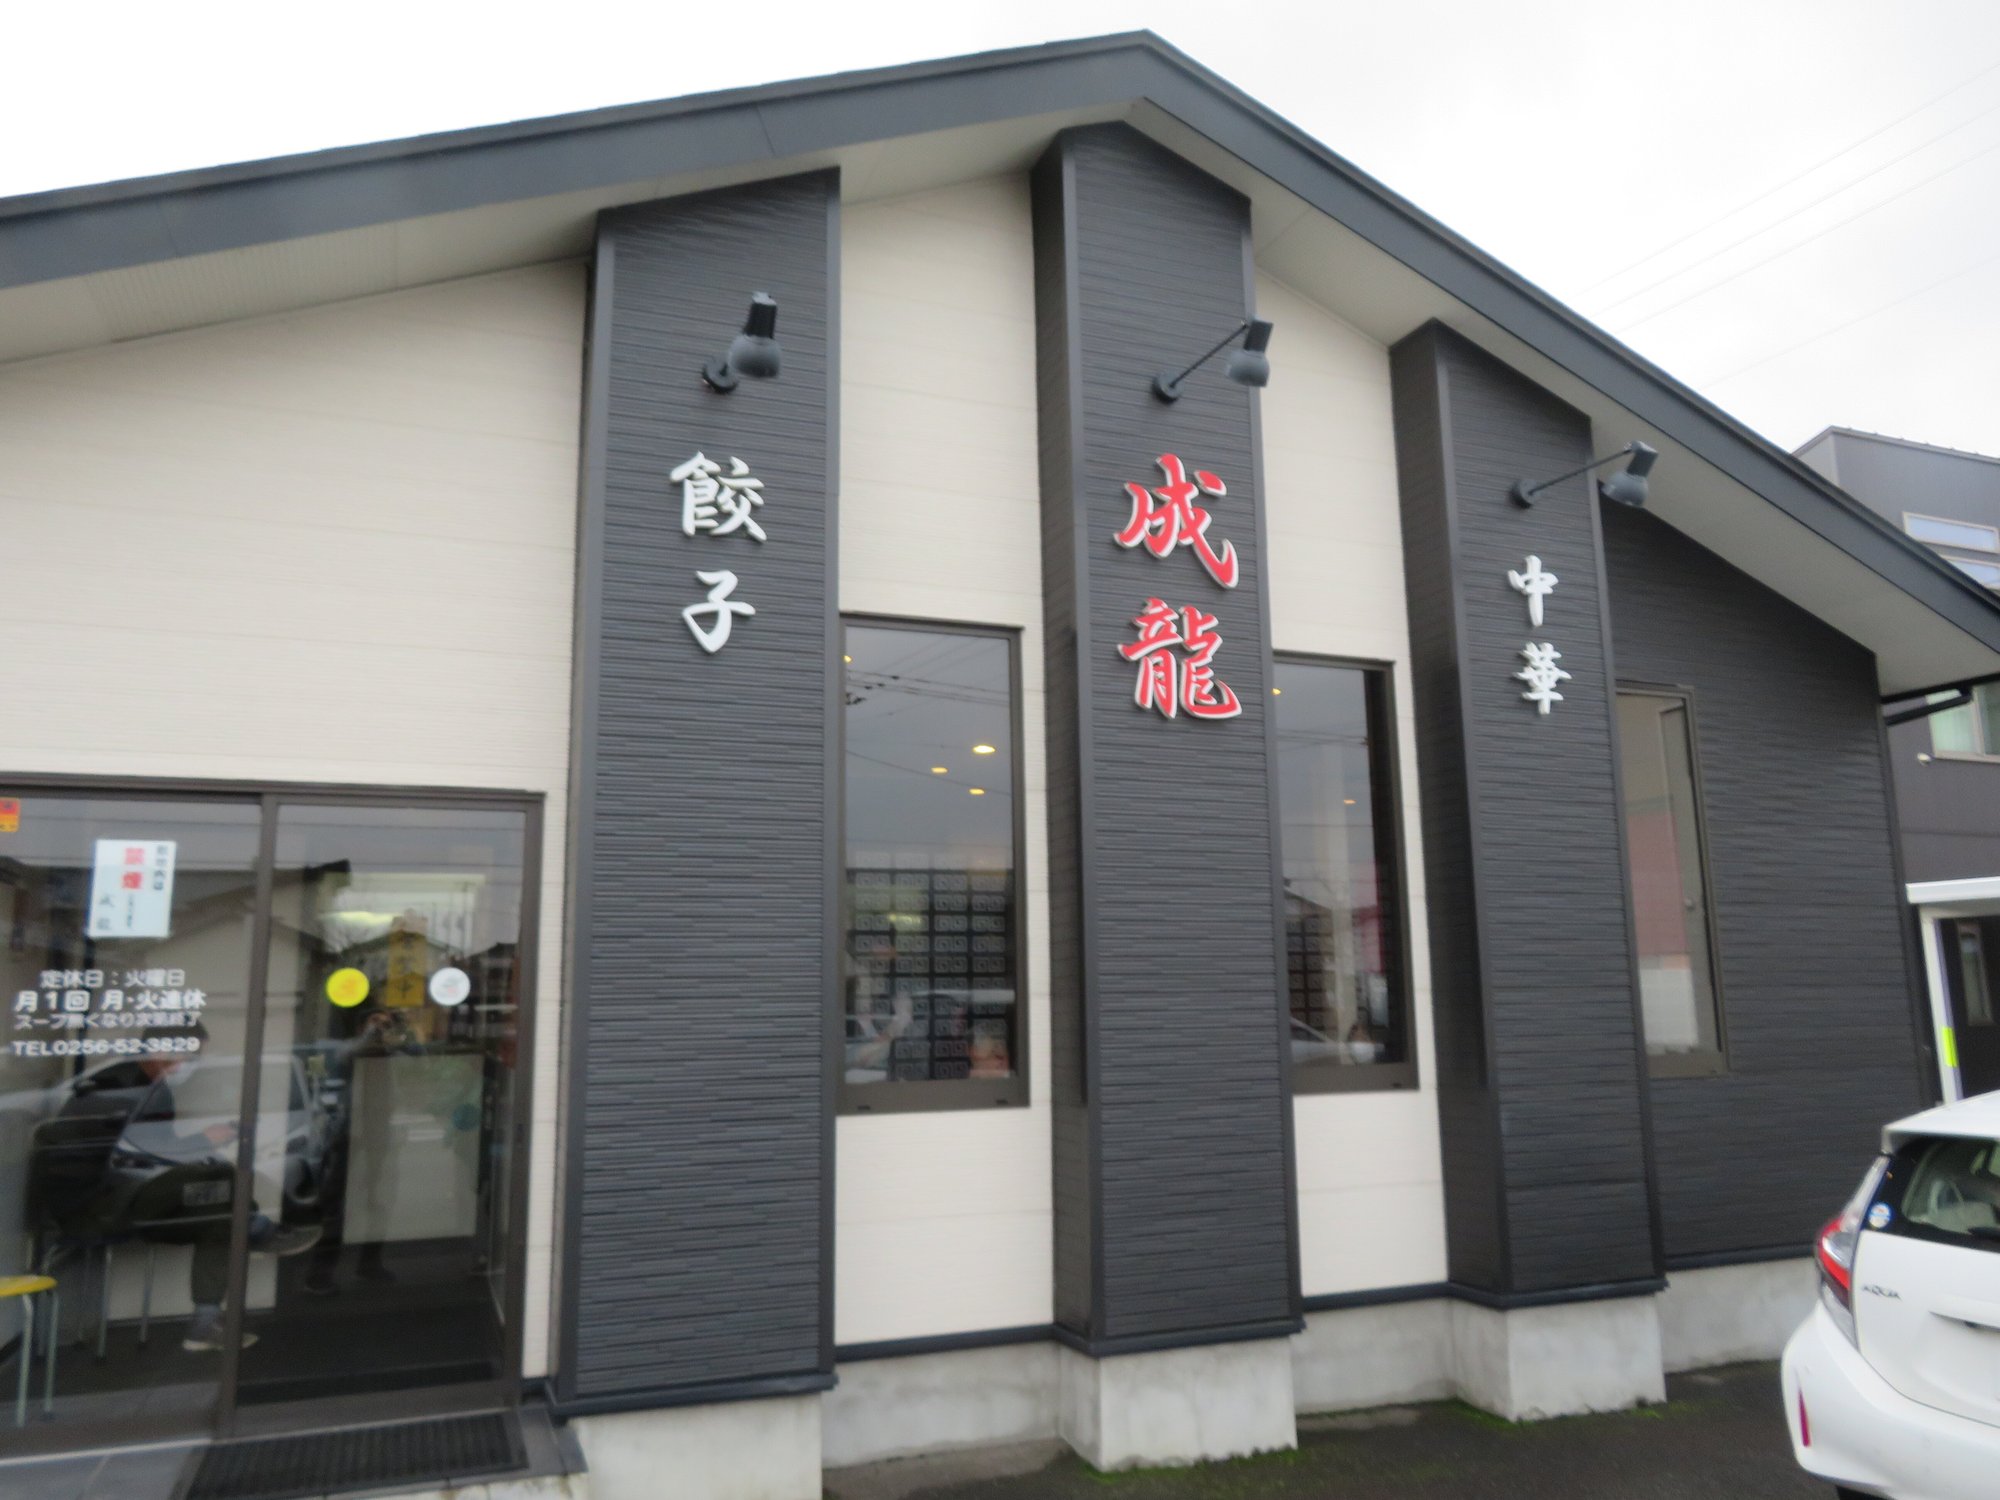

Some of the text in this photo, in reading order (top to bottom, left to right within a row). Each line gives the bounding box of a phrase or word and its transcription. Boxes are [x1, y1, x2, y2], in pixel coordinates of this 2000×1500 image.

[670, 451, 767, 653] 餃子
[1113, 453, 1242, 720] 成龍
[1507, 555, 1572, 715] 中華
[1861, 1284, 1901, 1300] AQUA
